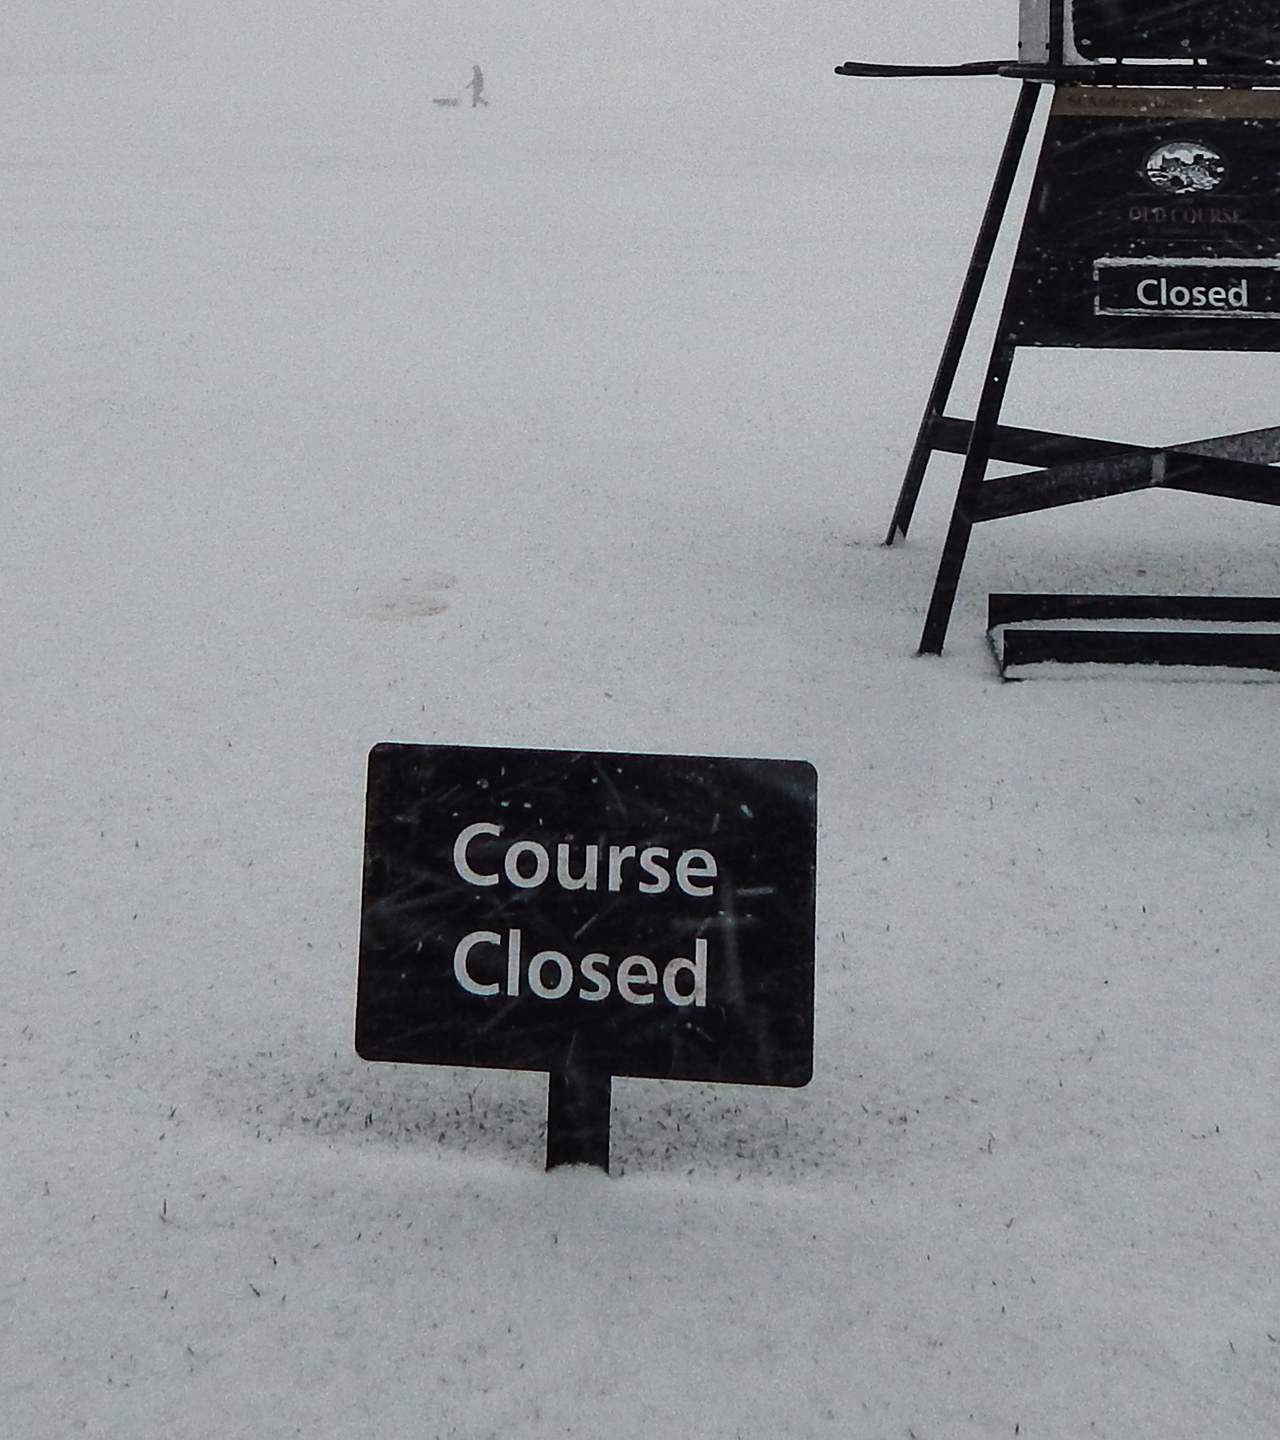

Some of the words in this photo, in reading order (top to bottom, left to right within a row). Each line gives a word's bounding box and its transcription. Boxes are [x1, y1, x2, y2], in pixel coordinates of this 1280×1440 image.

[1128, 206, 1166, 223] OLD
[1136, 278, 1248, 308] Closed
[452, 821, 718, 897] Course
[452, 928, 709, 1007] Closed
